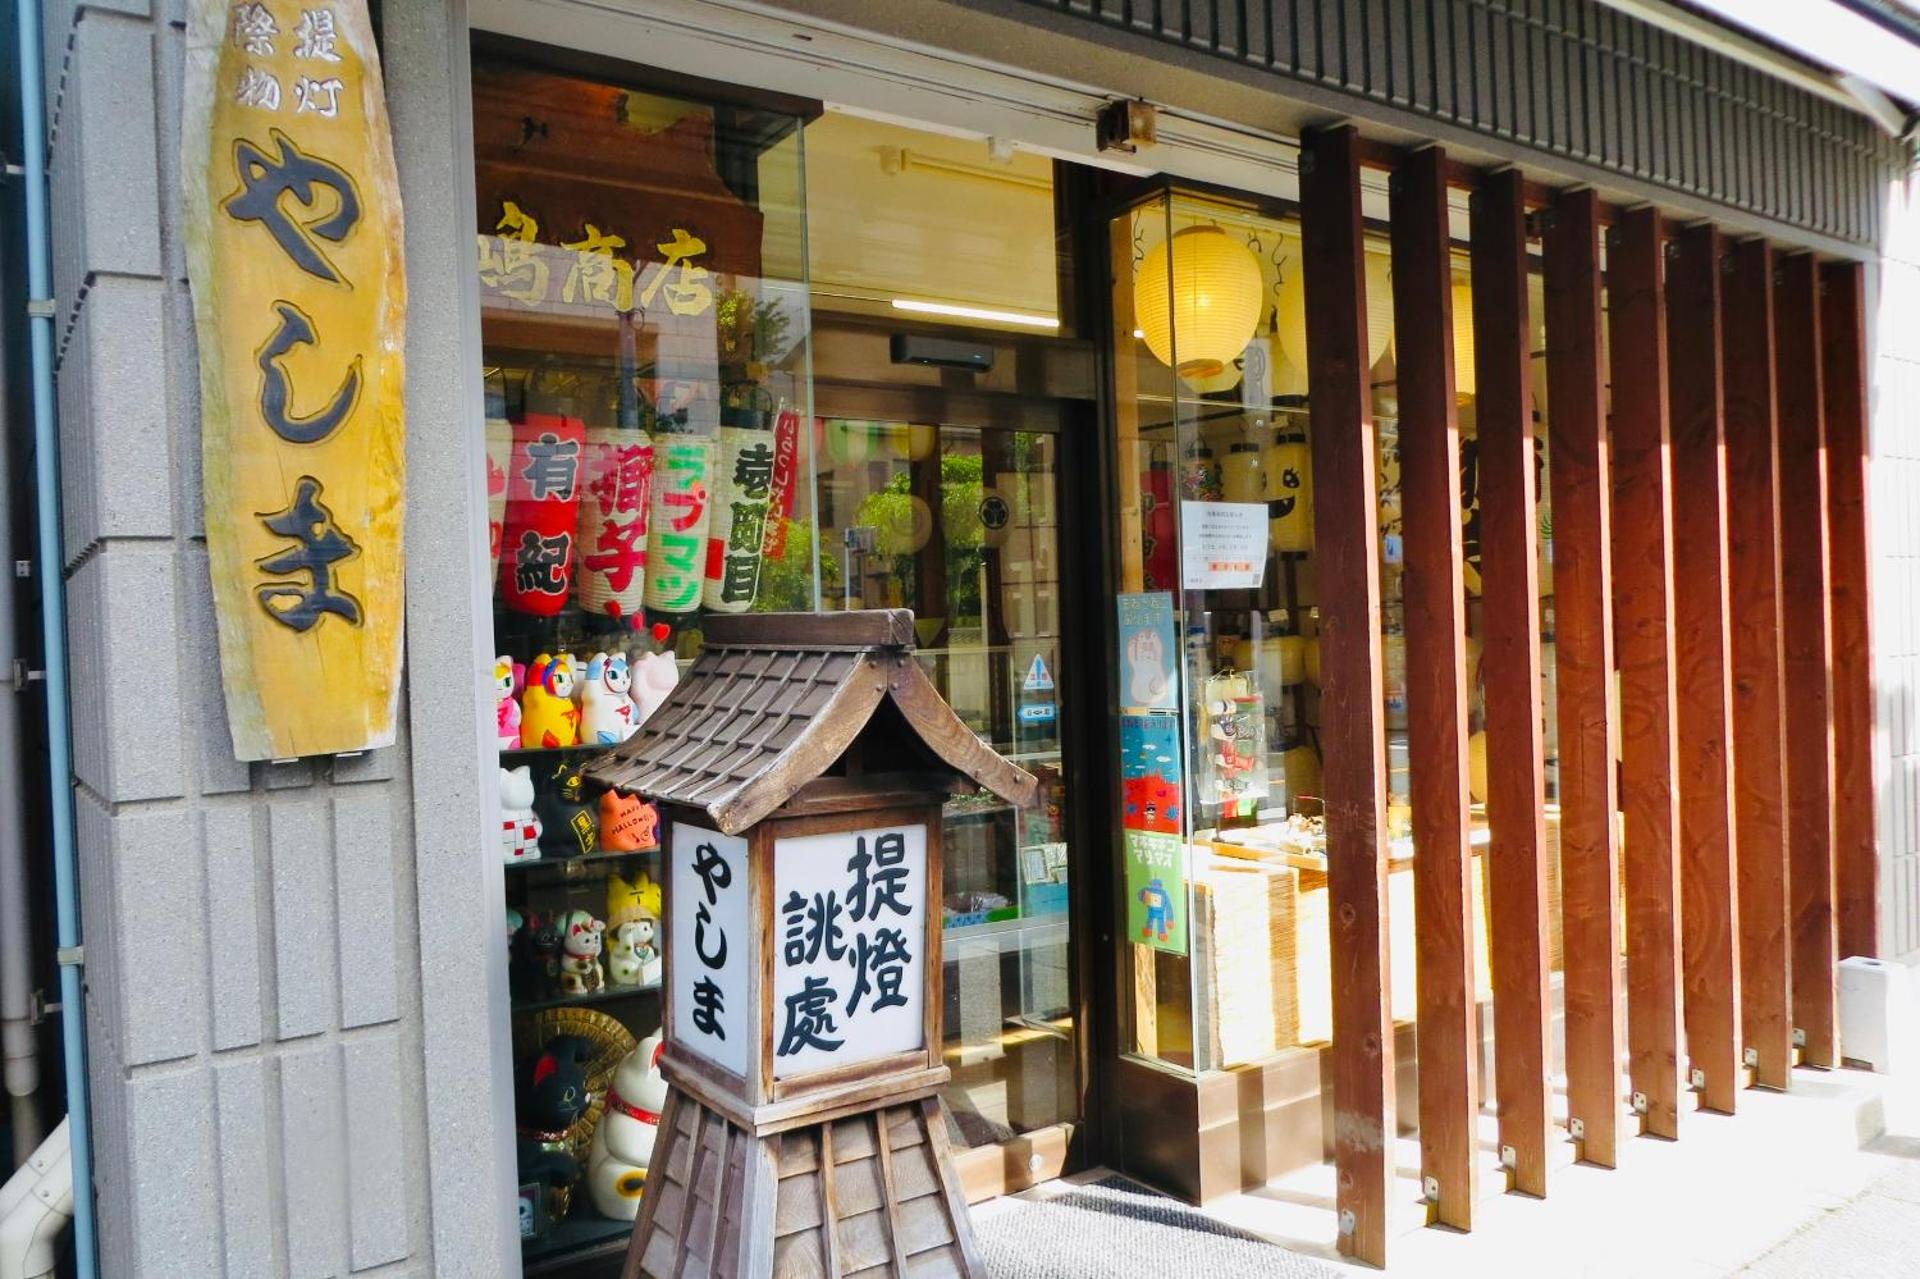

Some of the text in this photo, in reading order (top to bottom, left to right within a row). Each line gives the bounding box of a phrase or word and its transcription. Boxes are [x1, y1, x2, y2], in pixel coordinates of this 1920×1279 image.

[294, 8, 344, 119] 提灯
[222, 130, 363, 633] やしま
[691, 841, 732, 1042] やしま
[845, 832, 912, 1019] 提燈
